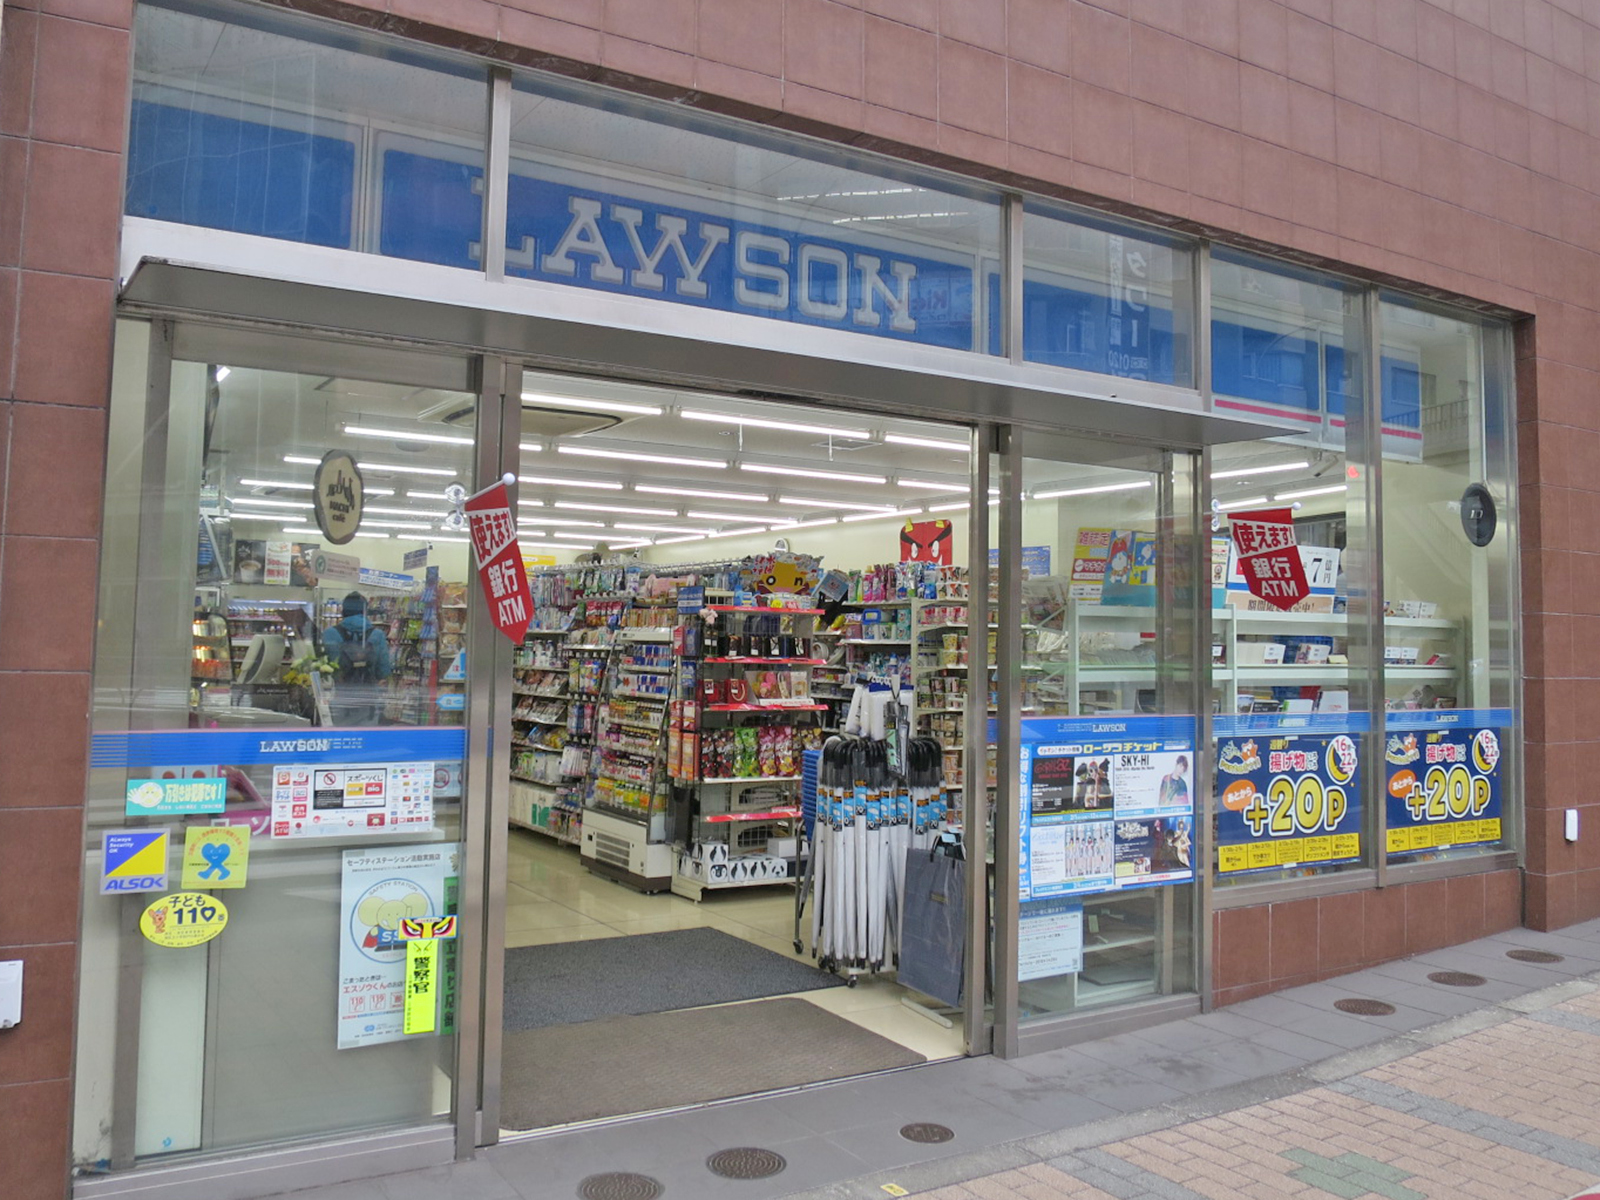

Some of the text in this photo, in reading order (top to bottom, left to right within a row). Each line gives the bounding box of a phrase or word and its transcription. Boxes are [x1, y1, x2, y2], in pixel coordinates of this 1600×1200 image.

[468, 175, 917, 334] LAWSON
[1232, 522, 1294, 555] 使えます!
[1251, 556, 1291, 579] 銀行
[488, 558, 518, 598] 銀行
[1261, 580, 1299, 597] ATM
[498, 595, 526, 627] ATM
[1092, 723, 1127, 733] LAWSON
[260, 738, 329, 753] LAWSON
[1121, 755, 1150, 767] SKY-HI
[105, 876, 164, 891] ALSOK
[369, 881, 418, 896] SAFETY STATION
[169, 894, 206, 908] 子ども
[414, 956, 430, 993] 警察官
